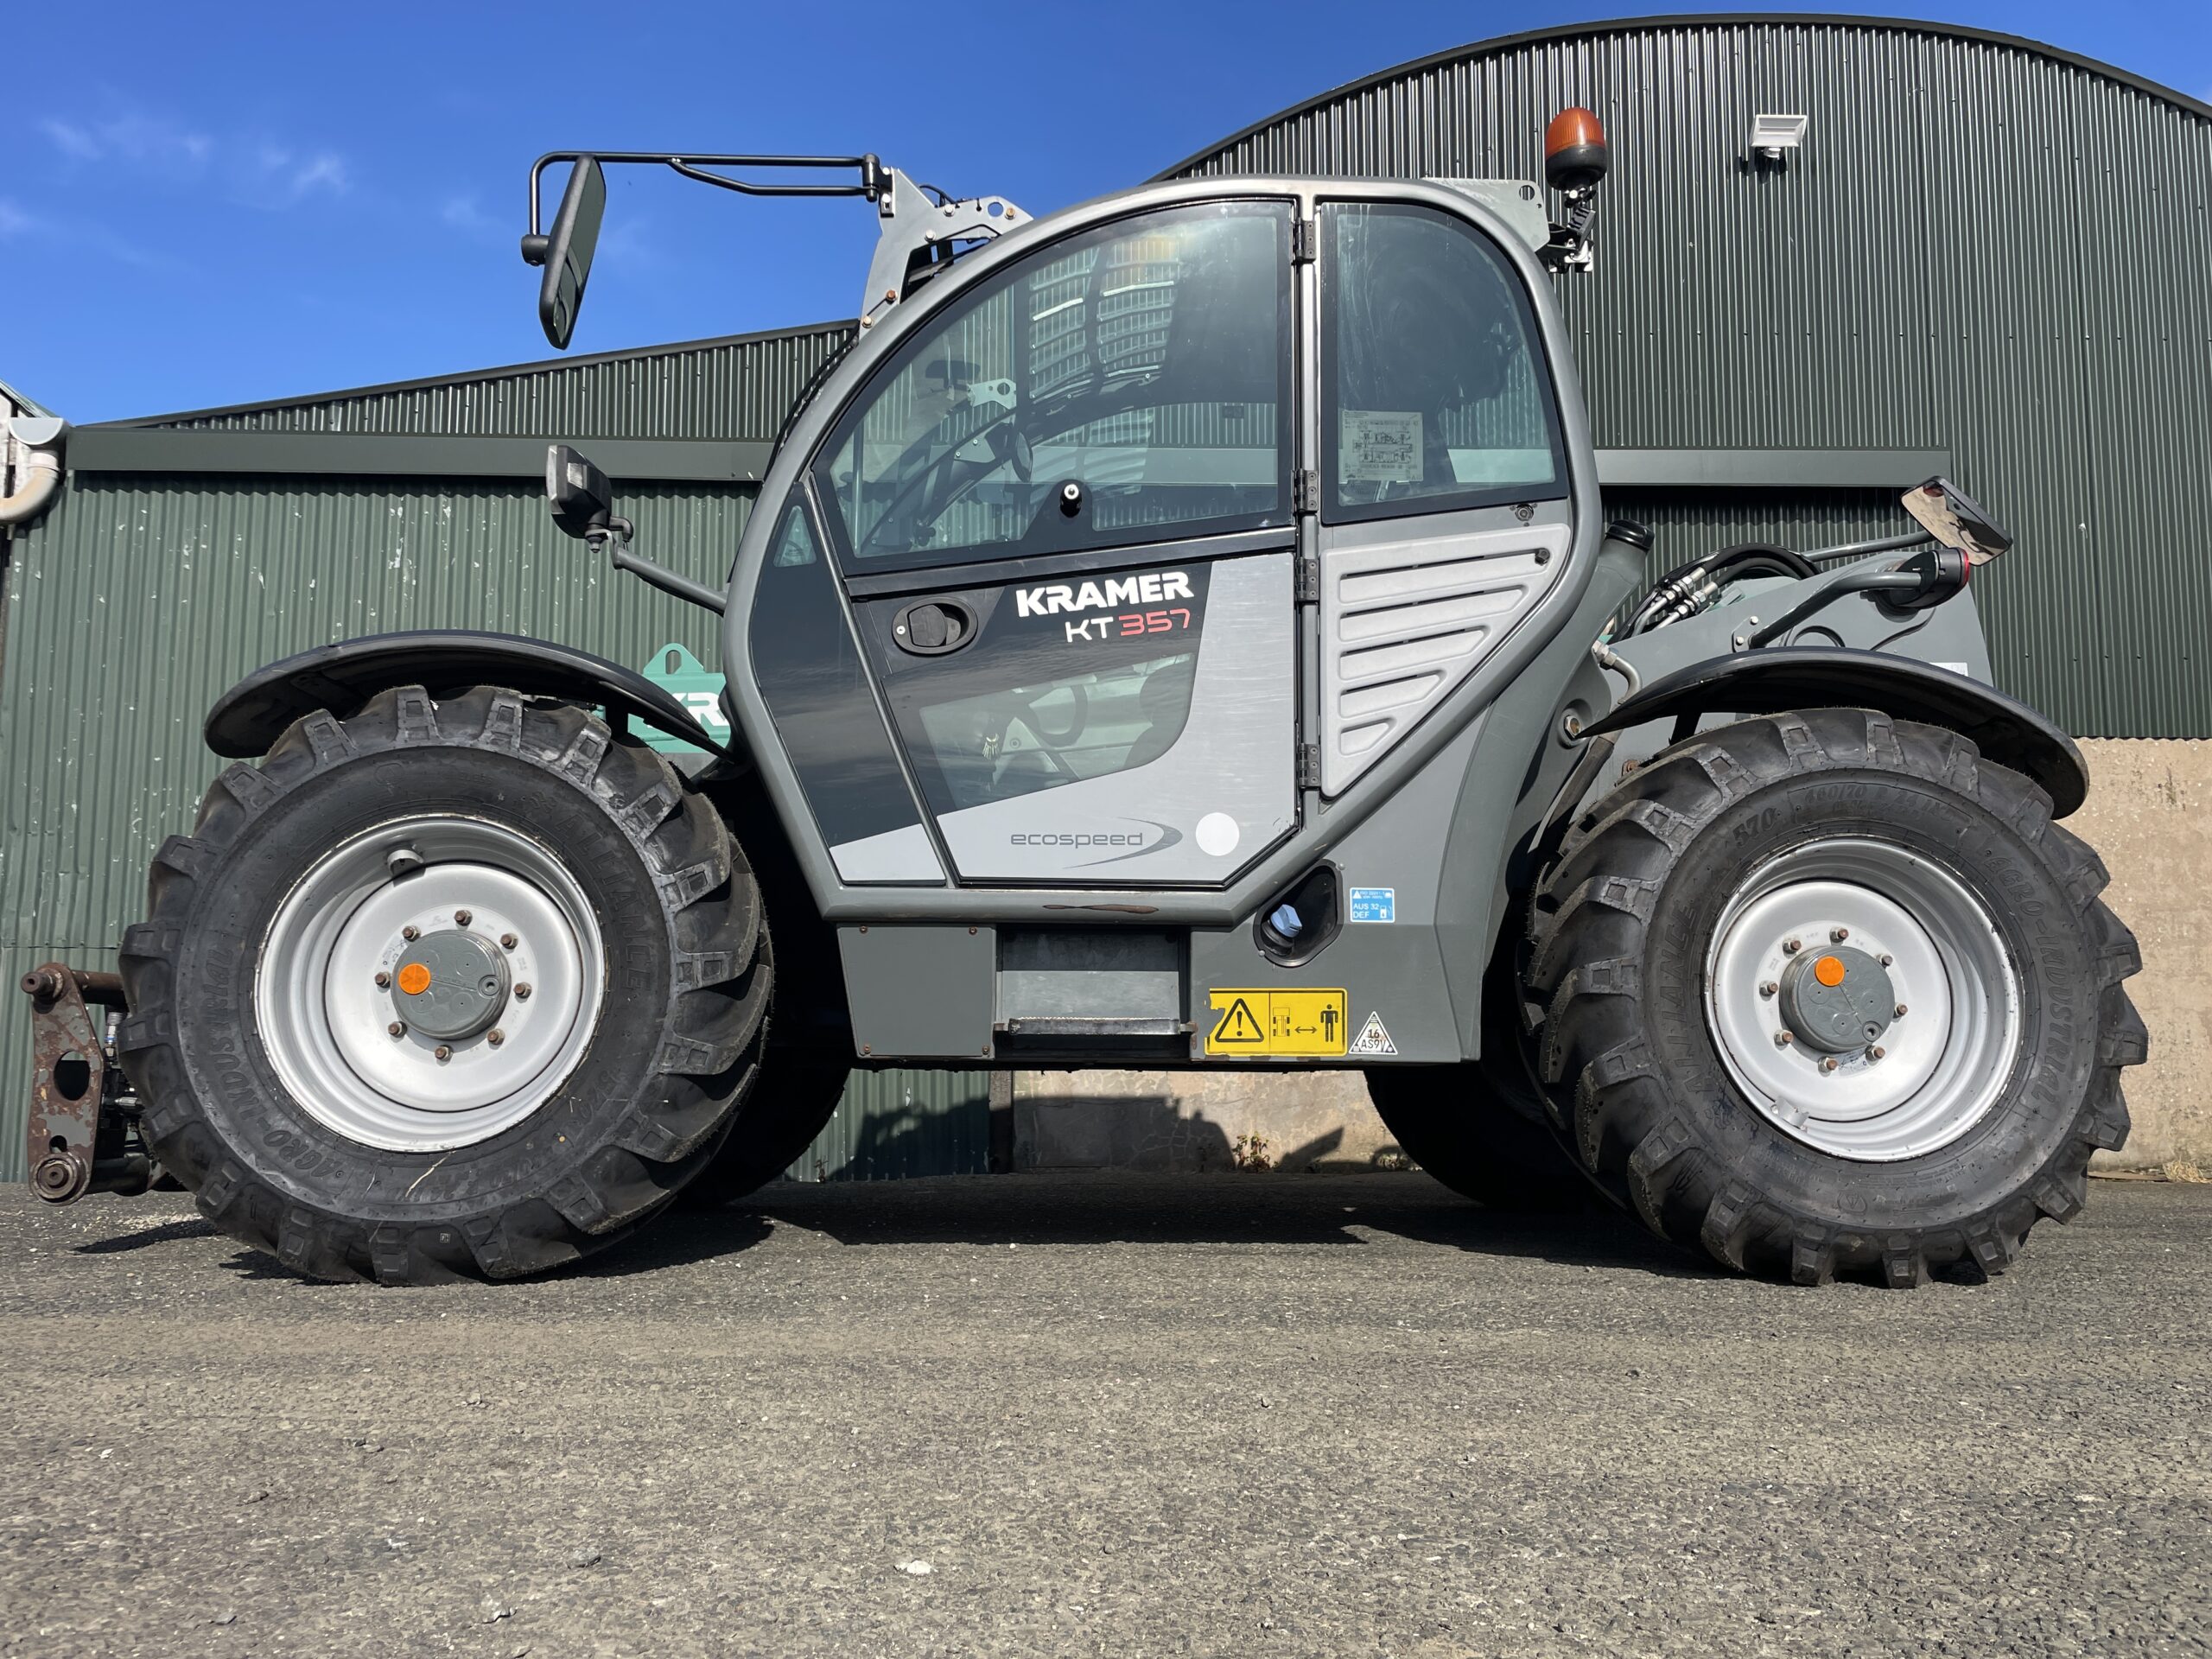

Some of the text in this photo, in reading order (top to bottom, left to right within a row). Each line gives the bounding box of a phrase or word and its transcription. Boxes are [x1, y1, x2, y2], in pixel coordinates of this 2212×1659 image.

[1016, 571, 1194, 617] KRAMER
[1065, 608, 1191, 642] KT 357
[1011, 832, 1143, 849] ecospeed
[555, 813, 652, 992] ALLIANCE
[1986, 855, 2073, 1105] AGRO-INDUSTRIAL
[1368, 1028, 1380, 1039] 16
[200, 946, 343, 1179] AGRO-INDUSTRIAL
